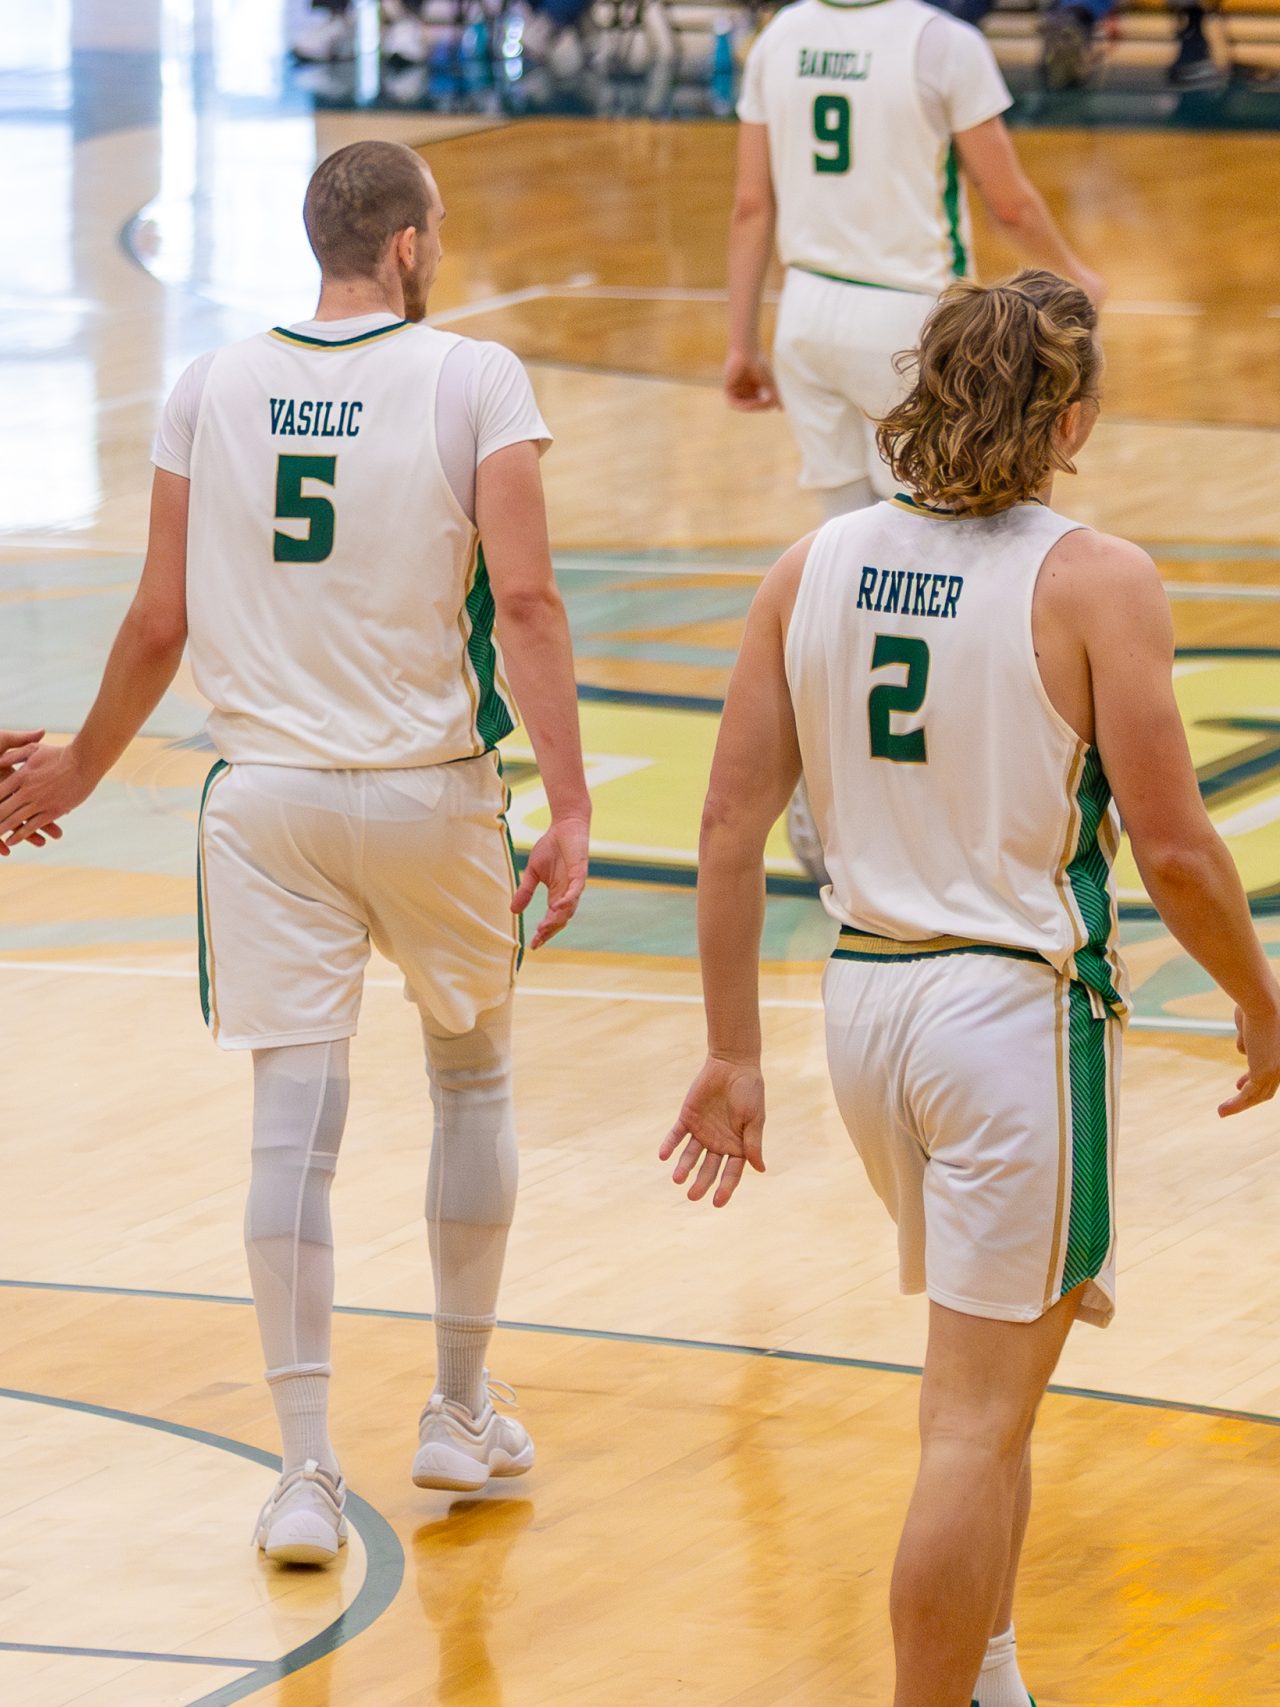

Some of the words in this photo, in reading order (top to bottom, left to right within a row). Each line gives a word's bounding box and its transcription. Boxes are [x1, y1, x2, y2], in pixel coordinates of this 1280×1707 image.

[812, 92, 853, 176] 9
[269, 397, 363, 437] VASILIC
[272, 453, 338, 564] 5
[856, 566, 964, 619] RINIKER
[868, 632, 931, 765] 2
